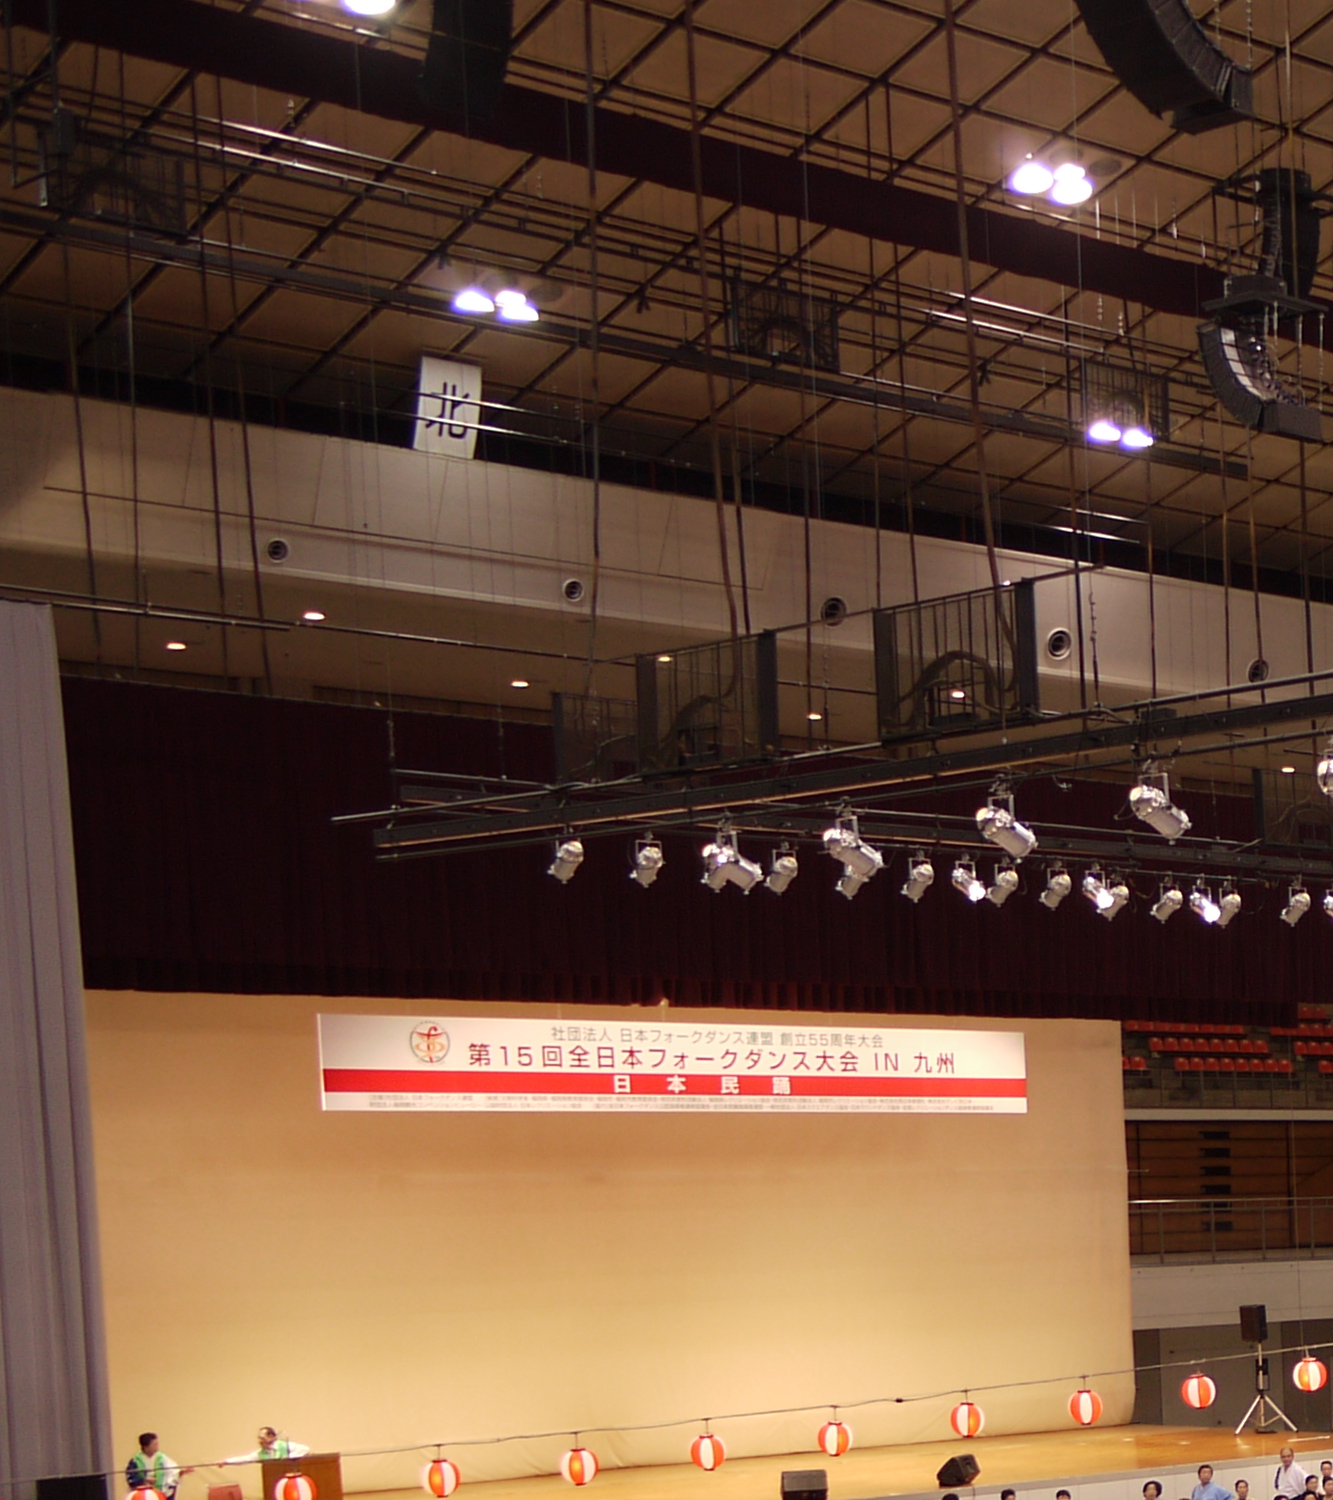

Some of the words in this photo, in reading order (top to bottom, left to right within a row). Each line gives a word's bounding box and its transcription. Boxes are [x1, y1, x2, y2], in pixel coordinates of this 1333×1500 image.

[425, 382, 470, 439] 北
[552, 1026, 613, 1042] 社団法人
[620, 1028, 774, 1046] 日本フォークダンス連盟
[780, 1032, 884, 1048] 創立55周年大会
[468, 1043, 859, 1073] 第15回全日本フォークダンス大会
[874, 1052, 899, 1072] IN
[913, 1051, 956, 1074] 九州
